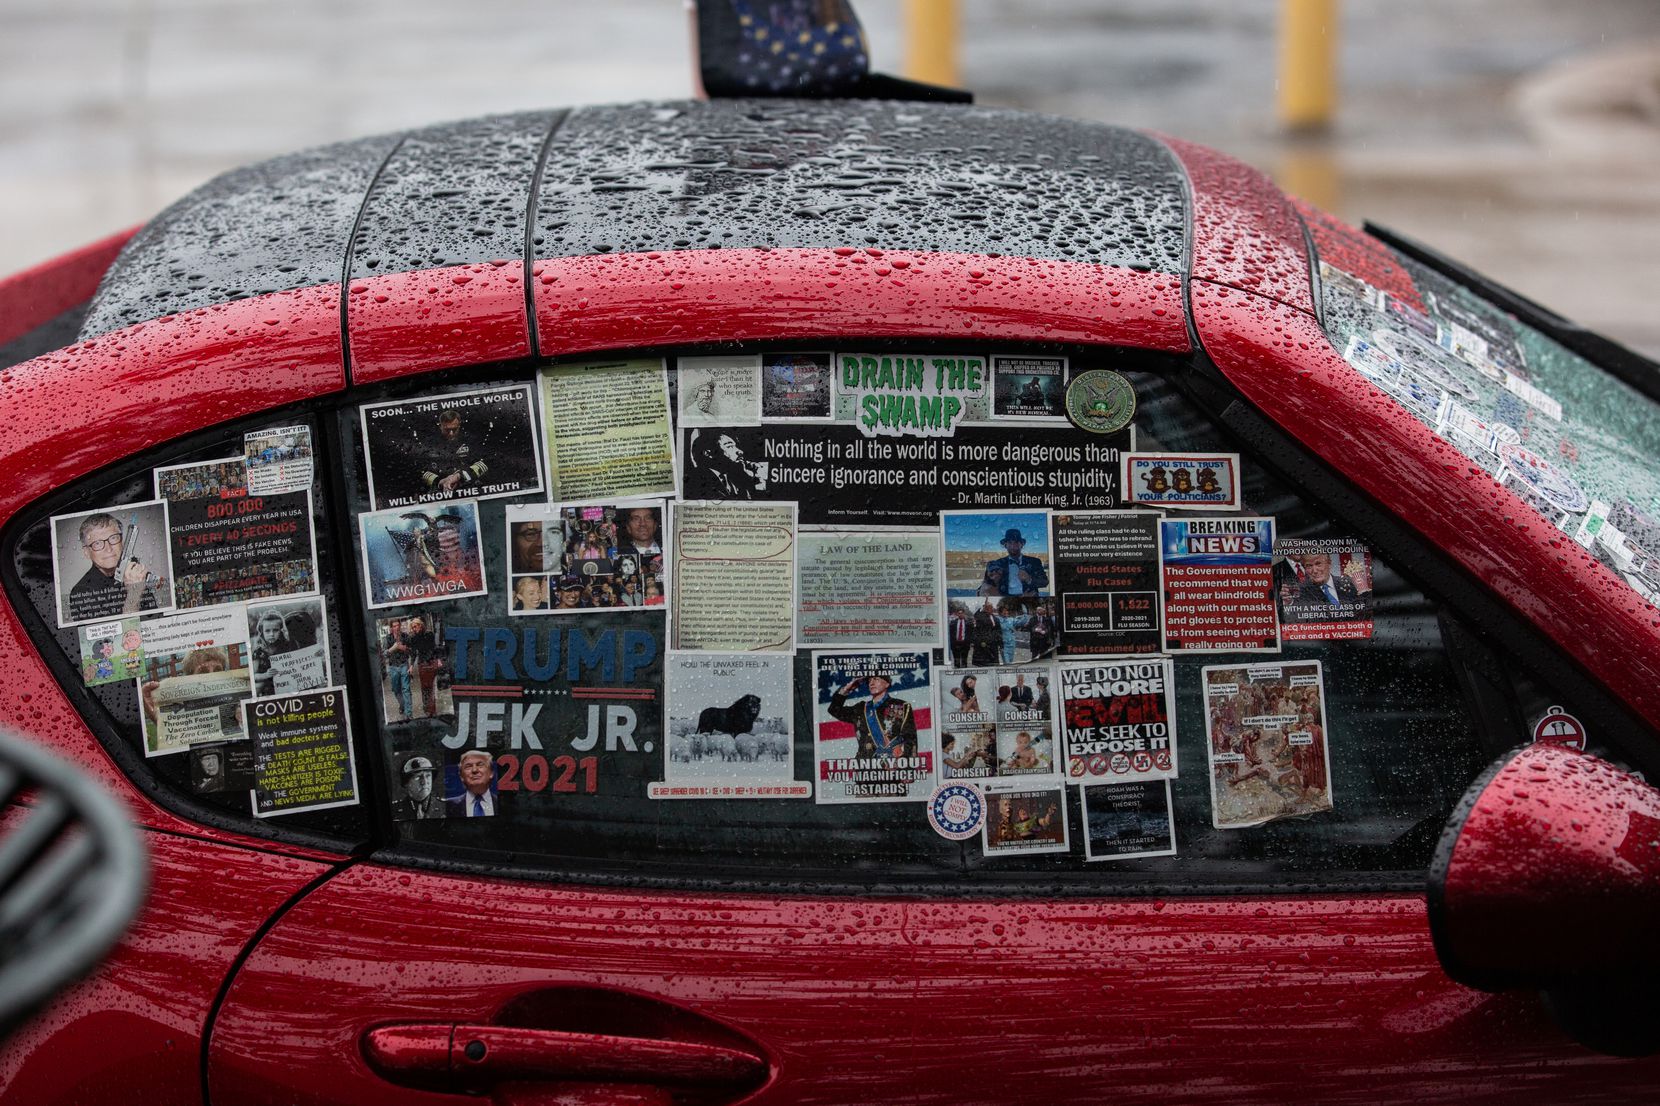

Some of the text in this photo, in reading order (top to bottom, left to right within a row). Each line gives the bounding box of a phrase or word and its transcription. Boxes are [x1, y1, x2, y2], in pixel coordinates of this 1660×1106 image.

[843, 357, 924, 392] DRAIN
[932, 358, 982, 394] THE
[372, 392, 523, 418] SOON... THE WHOLE WORLD
[862, 394, 961, 432] SWAMP
[247, 431, 278, 439] AMAZING,
[764, 438, 1118, 465] Nothing in all the world is more dangerous than
[771, 465, 1116, 492] sincere ignorance and conscientious stupidity.
[389, 482, 520, 507] WILL KNOW THE TRUTH
[958, 492, 972, 504] Dr.
[975, 492, 1006, 504] Martin
[1010, 493, 1042, 505] Luther
[1044, 494, 1069, 507] King,
[1072, 495, 1082, 505] Jr.
[1085, 495, 1114, 507] (1963)
[207, 498, 263, 518] 800.000
[171, 523, 203, 532] CHILDREN
[205, 518, 240, 528] DISAPPEAR
[242, 515, 260, 523] EVERY
[262, 512, 279, 520] YEAR
[1190, 521, 1255, 534] BREAKING
[820, 546, 843, 554] LAW
[862, 545, 882, 553] THE
[885, 544, 912, 552] LAND
[1192, 538, 1255, 552] NEWS
[1273, 546, 1369, 555] HYDROXYCHLOROQUINE
[1077, 565, 1142, 574] United States
[1166, 567, 1184, 575] The
[1187, 567, 1248, 575] Government
[387, 579, 467, 599] WWG1WGA
[1087, 578, 1132, 586] Flu Cases
[1232, 579, 1252, 587] that
[1215, 591, 1264, 599] blindfolds
[1119, 600, 1149, 610] 1,822
[1168, 605, 1195, 614] along
[1197, 604, 1219, 612] with
[1189, 617, 1221, 626] gloves
[1236, 616, 1273, 625] protect
[1207, 629, 1240, 637] seeing
[445, 627, 656, 682] TRUMP
[1063, 669, 1091, 684] WE
[1095, 666, 1121, 681] DO
[1125, 664, 1161, 680] NOT
[1064, 679, 1163, 700] IGNORE
[255, 699, 303, 717] COVID
[322, 694, 335, 707] 19
[164, 714, 219, 728] Through Forced
[167, 708, 214, 721] Depopulation
[267, 717, 280, 725] not
[283, 713, 304, 723] killing
[307, 709, 335, 720] people.
[950, 711, 988, 722] CONSENT
[1004, 710, 1043, 721] CONSENT
[258, 723, 338, 739] Weak immune systems
[441, 702, 654, 752] JFK JR.
[1068, 723, 1166, 743] WE SEEK TO
[261, 739, 274, 748] and
[276, 738, 289, 746] bad
[292, 734, 319, 743] doctors
[1070, 737, 1168, 755] EXPOSE IT
[827, 757, 926, 770] THANK YOU!
[497, 754, 598, 793] 2021
[827, 770, 928, 782] YOU MAGNIFICENT
[951, 767, 991, 778] CONSENT
[845, 783, 909, 795] BASTARDS!
[949, 805, 965, 814] NOT
